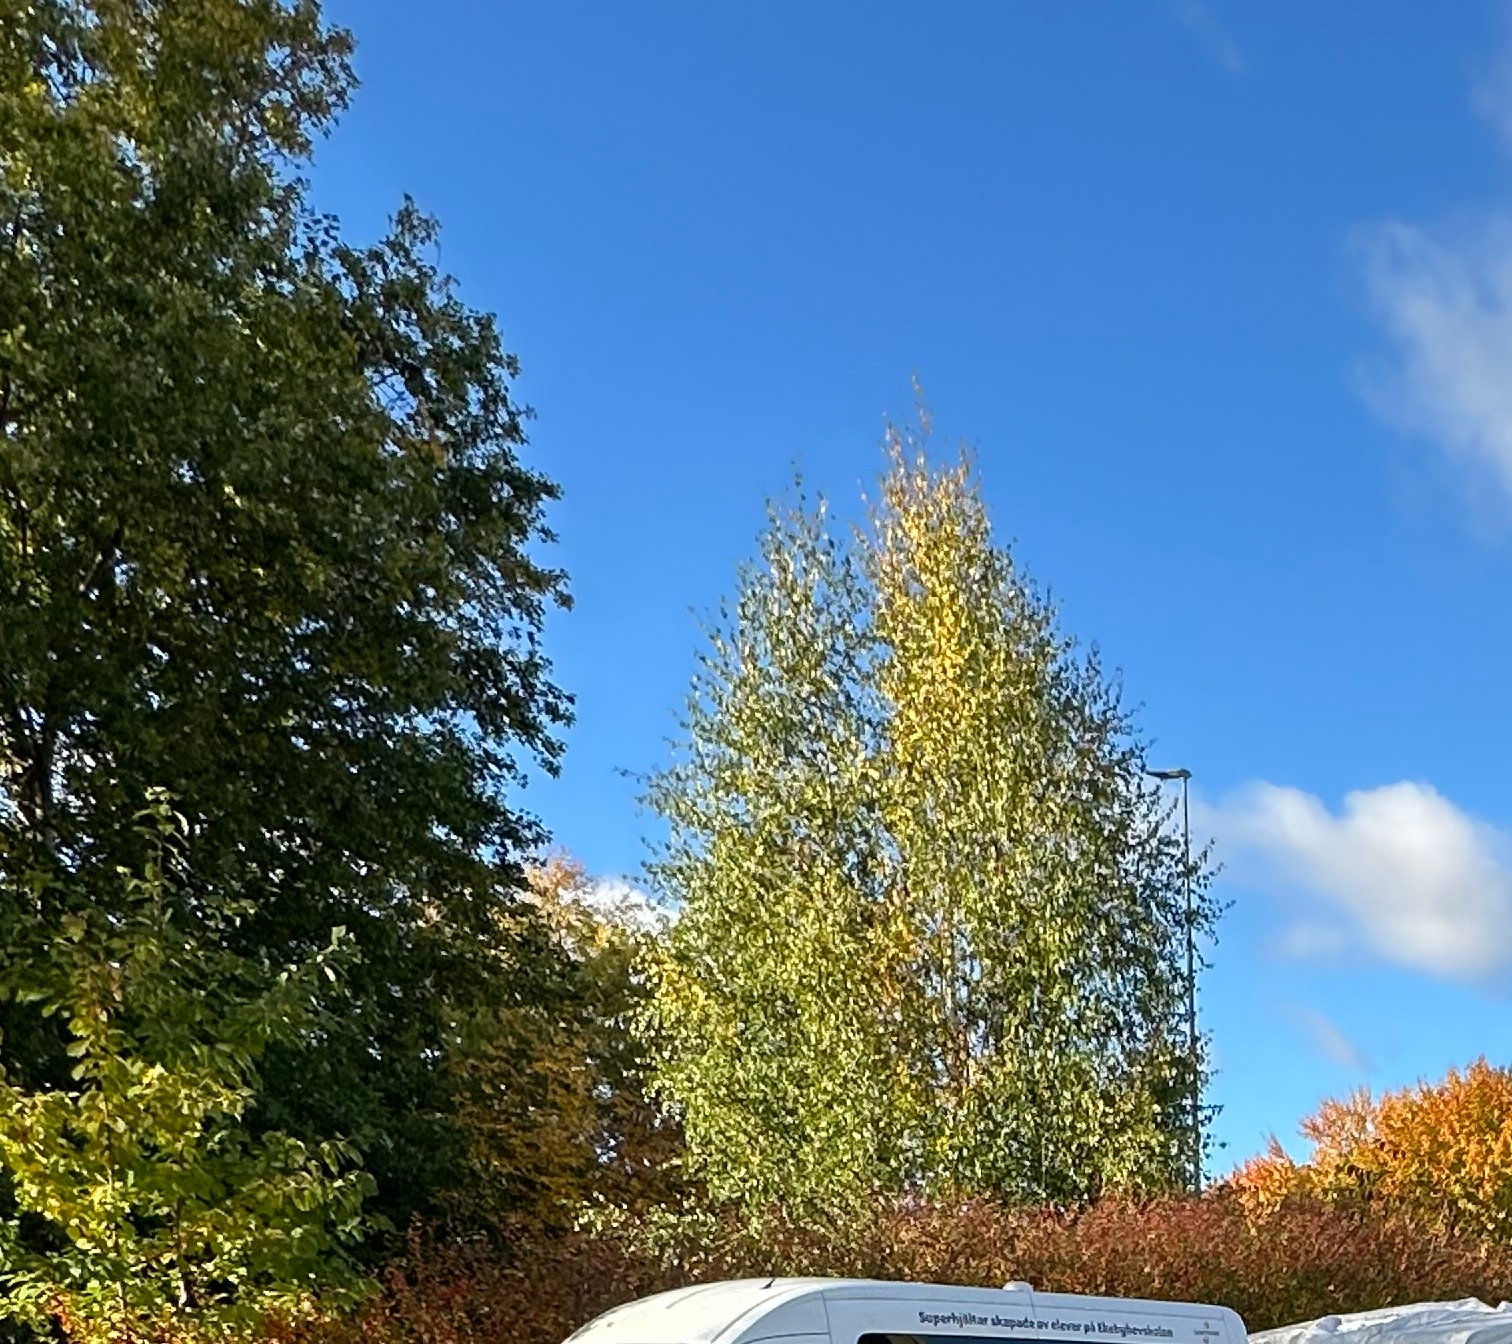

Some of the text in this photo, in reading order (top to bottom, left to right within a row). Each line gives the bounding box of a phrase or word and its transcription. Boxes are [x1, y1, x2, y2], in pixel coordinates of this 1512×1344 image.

[918, 1311, 988, 1328] Superhjältar
[991, 1315, 1035, 1331] skapade
[1037, 1320, 1049, 1330] av
[1051, 1319, 1082, 1332] elever
[1084, 1320, 1096, 1335] på
